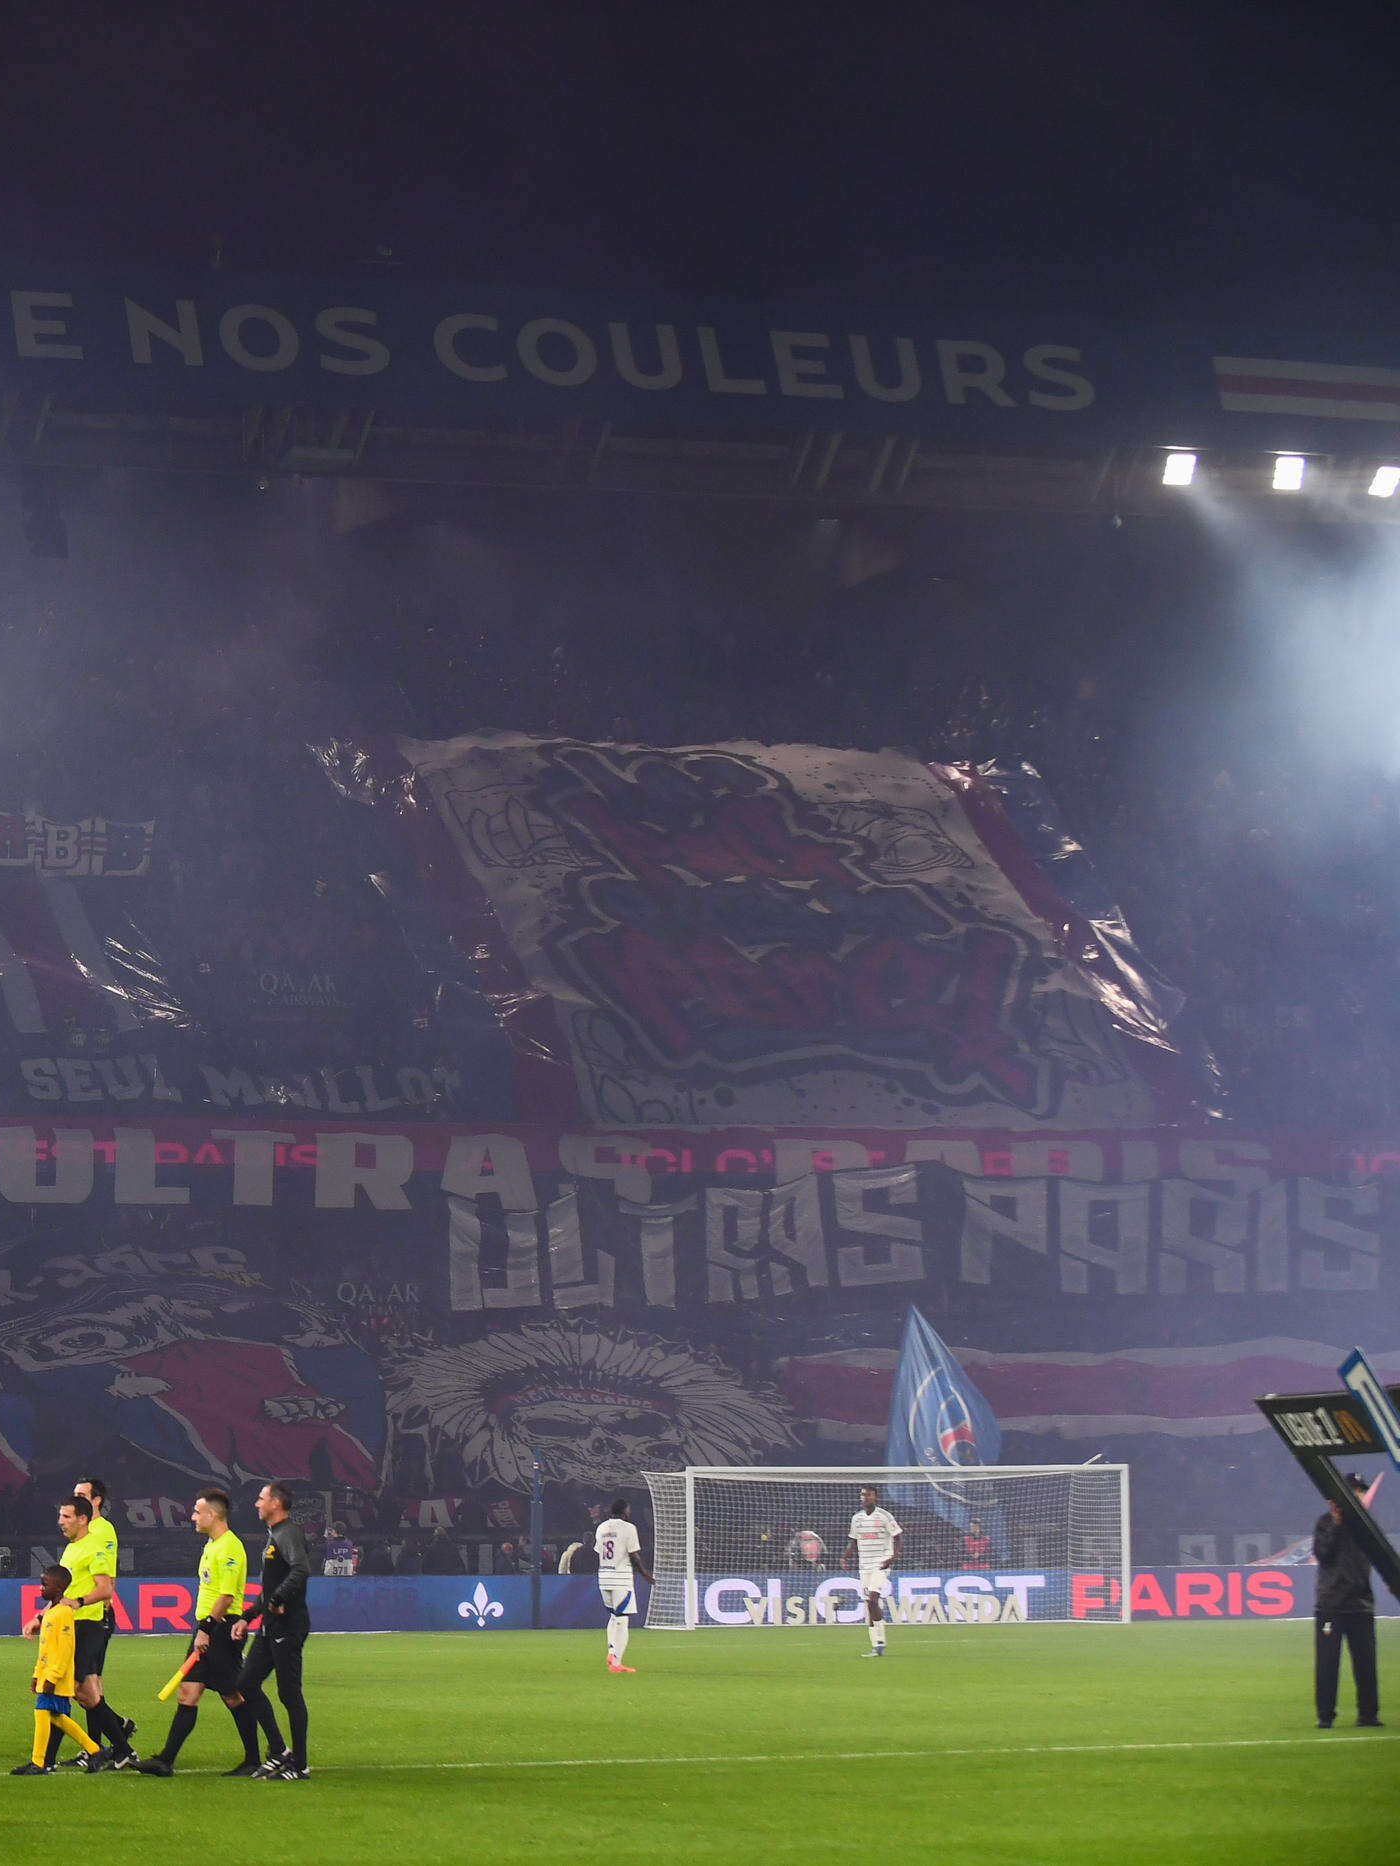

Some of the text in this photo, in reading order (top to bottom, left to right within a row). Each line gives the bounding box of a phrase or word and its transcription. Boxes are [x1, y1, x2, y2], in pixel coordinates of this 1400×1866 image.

[123, 295, 392, 376] NOS
[432, 312, 1097, 412] COULEURS
[259, 972, 338, 996] QAAR
[19, 1054, 183, 1104] SEUL
[446, 1168, 1384, 1312] ULTRAS PARIS
[336, 1281, 420, 1306] QAAR
[602, 1540, 614, 1560] 18
[742, 1594, 1028, 1626] VISIT WANDA
[1071, 1570, 1295, 1619] PARIS
